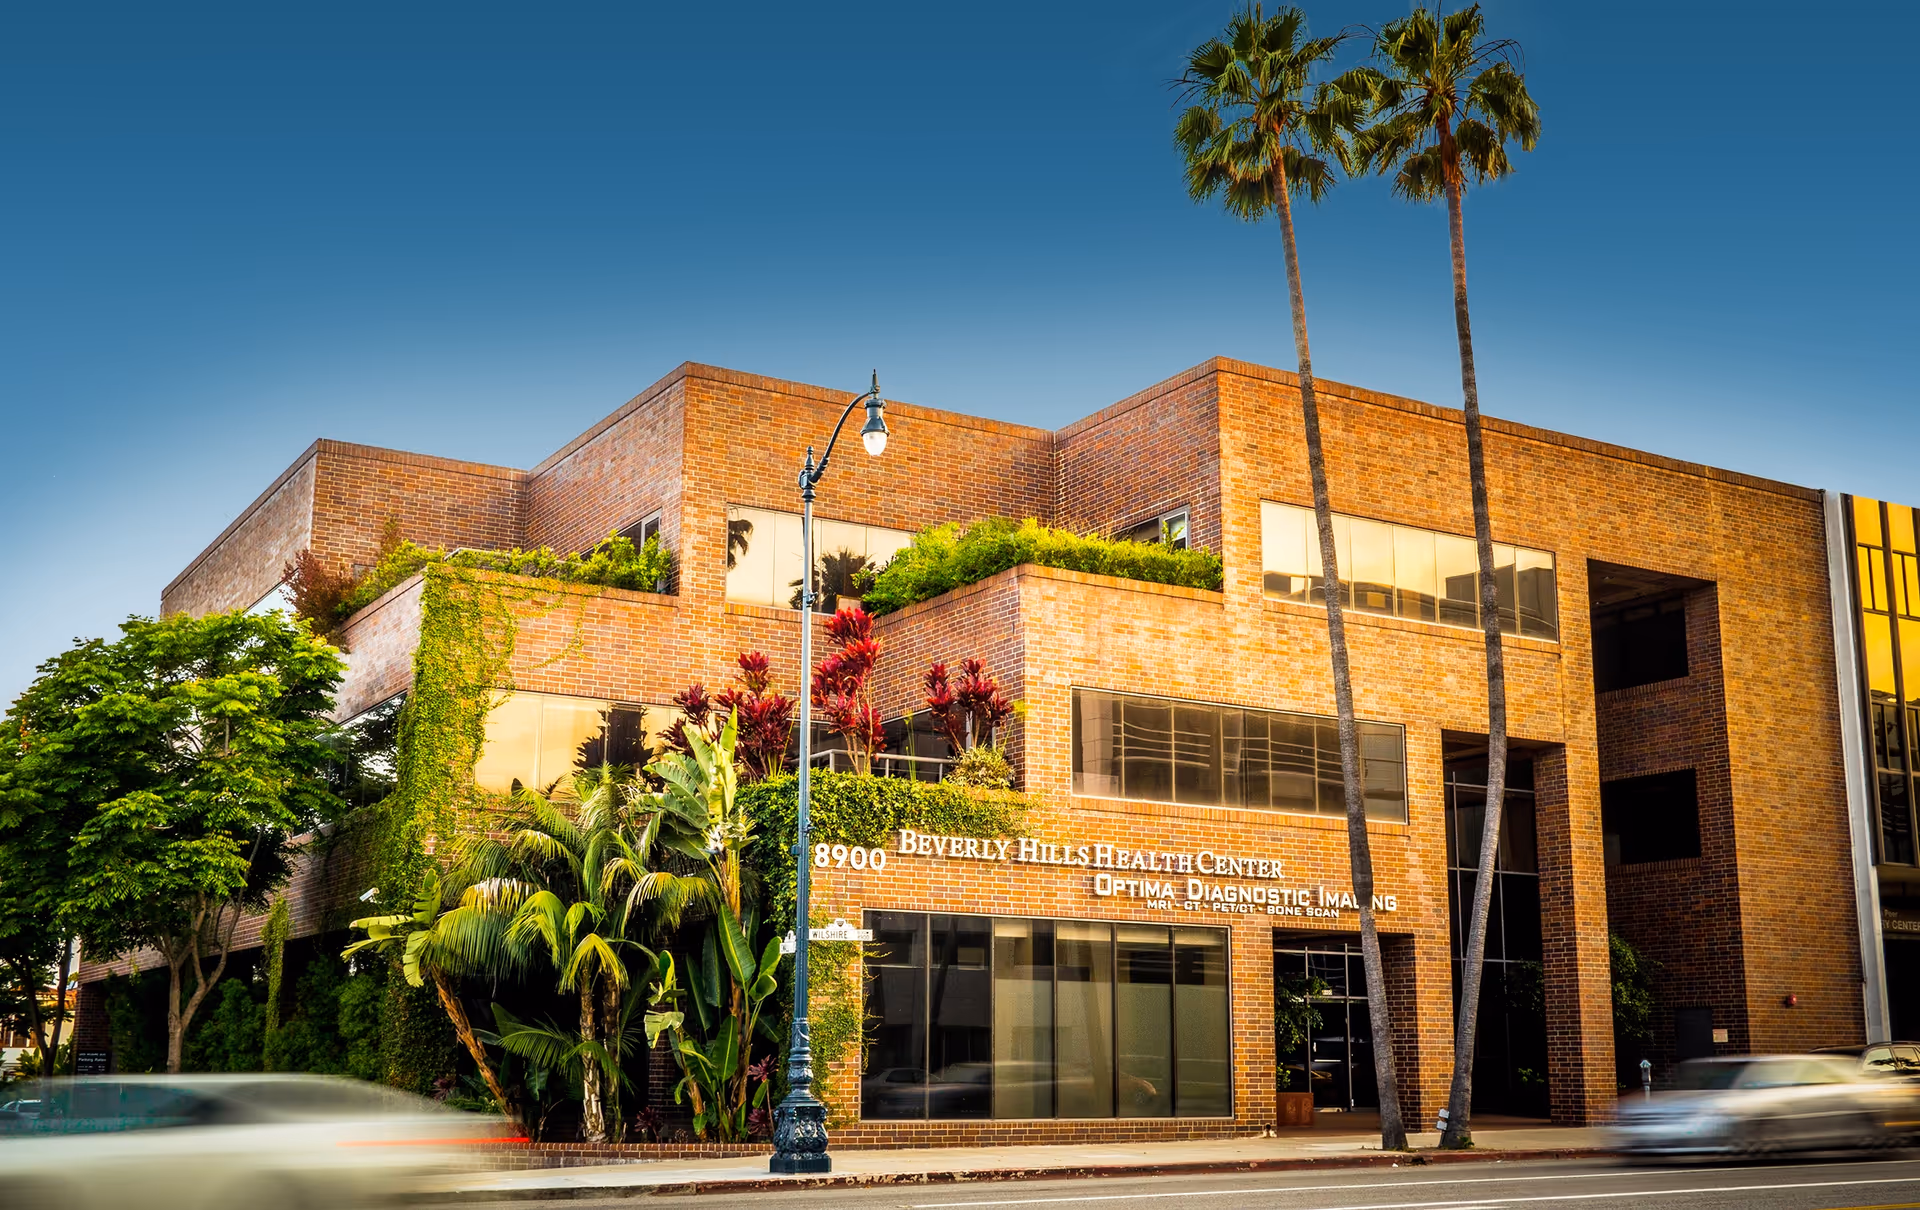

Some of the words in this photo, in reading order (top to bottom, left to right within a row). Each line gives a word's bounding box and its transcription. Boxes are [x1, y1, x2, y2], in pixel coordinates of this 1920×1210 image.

[814, 843, 887, 871] 8900
[898, 829, 1011, 860] BEVERLY
[1017, 837, 1089, 865] HILLS
[1095, 873, 1175, 899] OPTIMA
[1187, 878, 1310, 906] DIAGNOSTIC
[1319, 885, 1397, 911] IMANG
[1147, 899, 1171, 910] MRI
[1184, 901, 1200, 911] CT
[1212, 902, 1255, 914] PET/CT
[1267, 905, 1302, 916] BONE
[1306, 907, 1340, 918] SCAN
[812, 930, 848, 939] WILSHIRE
